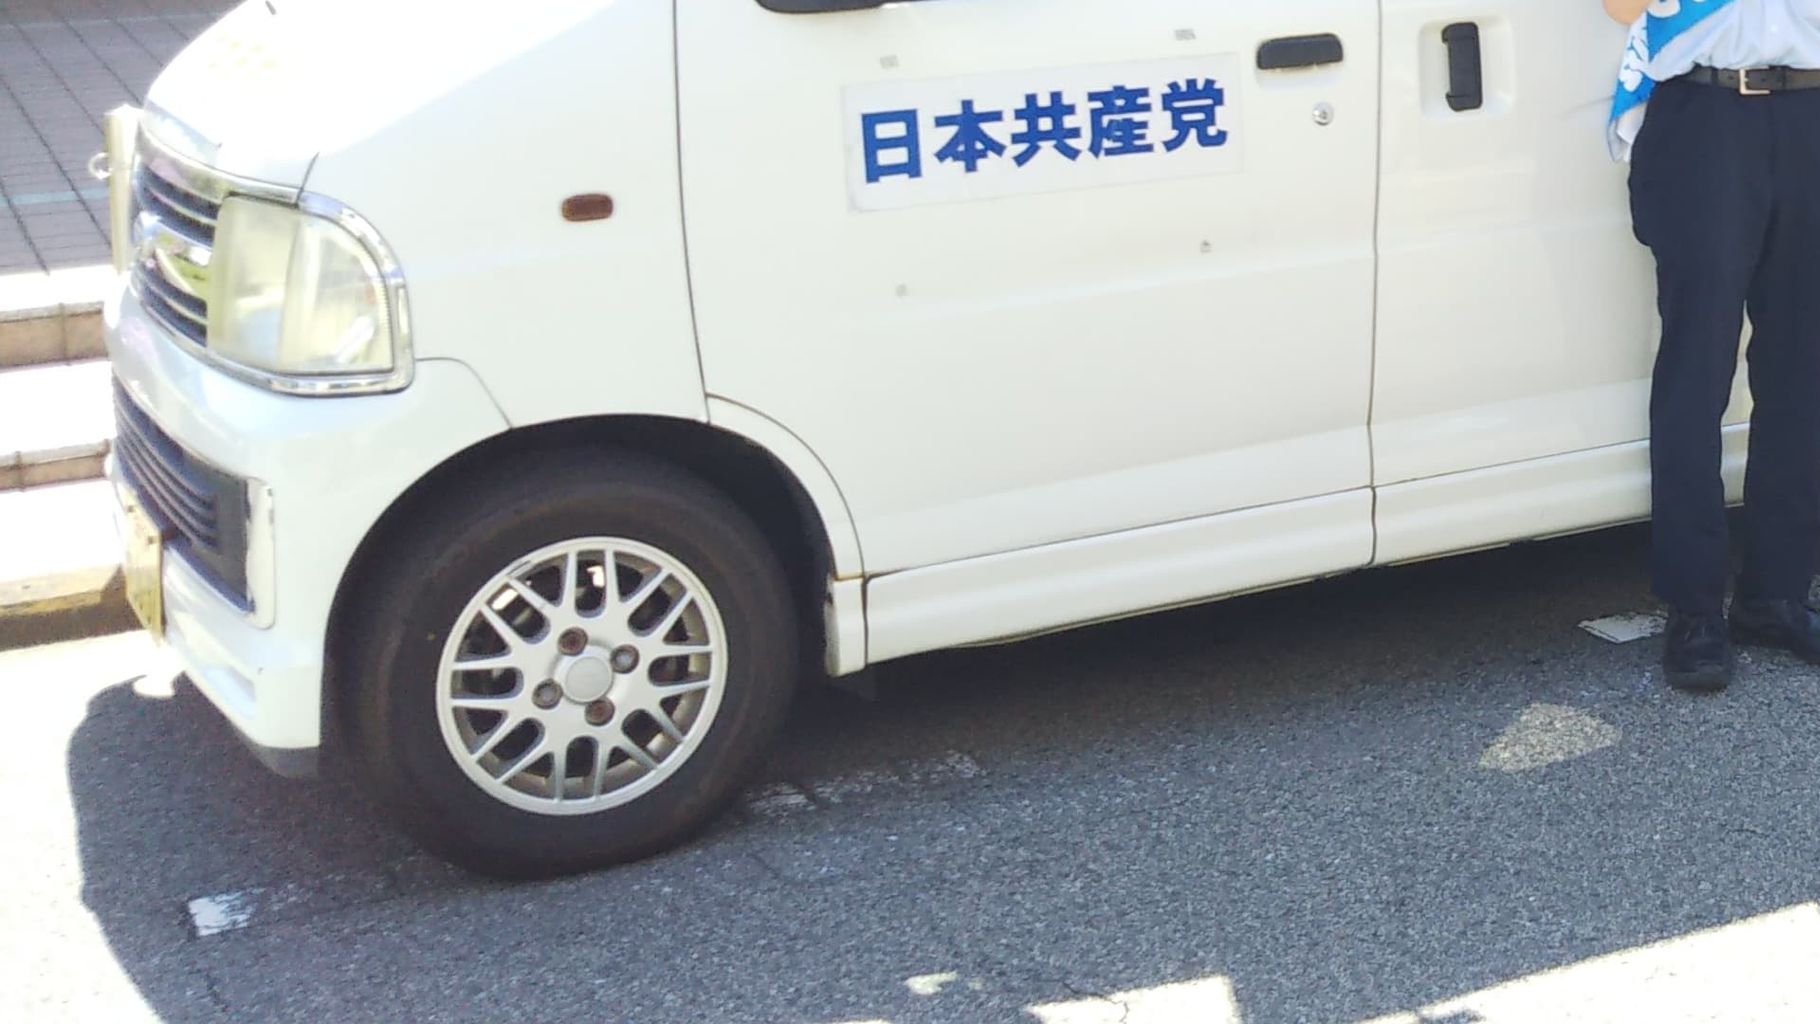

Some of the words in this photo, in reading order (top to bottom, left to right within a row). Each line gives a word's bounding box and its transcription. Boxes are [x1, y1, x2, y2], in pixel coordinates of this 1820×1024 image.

[861, 78, 1228, 184] 日本共産党
